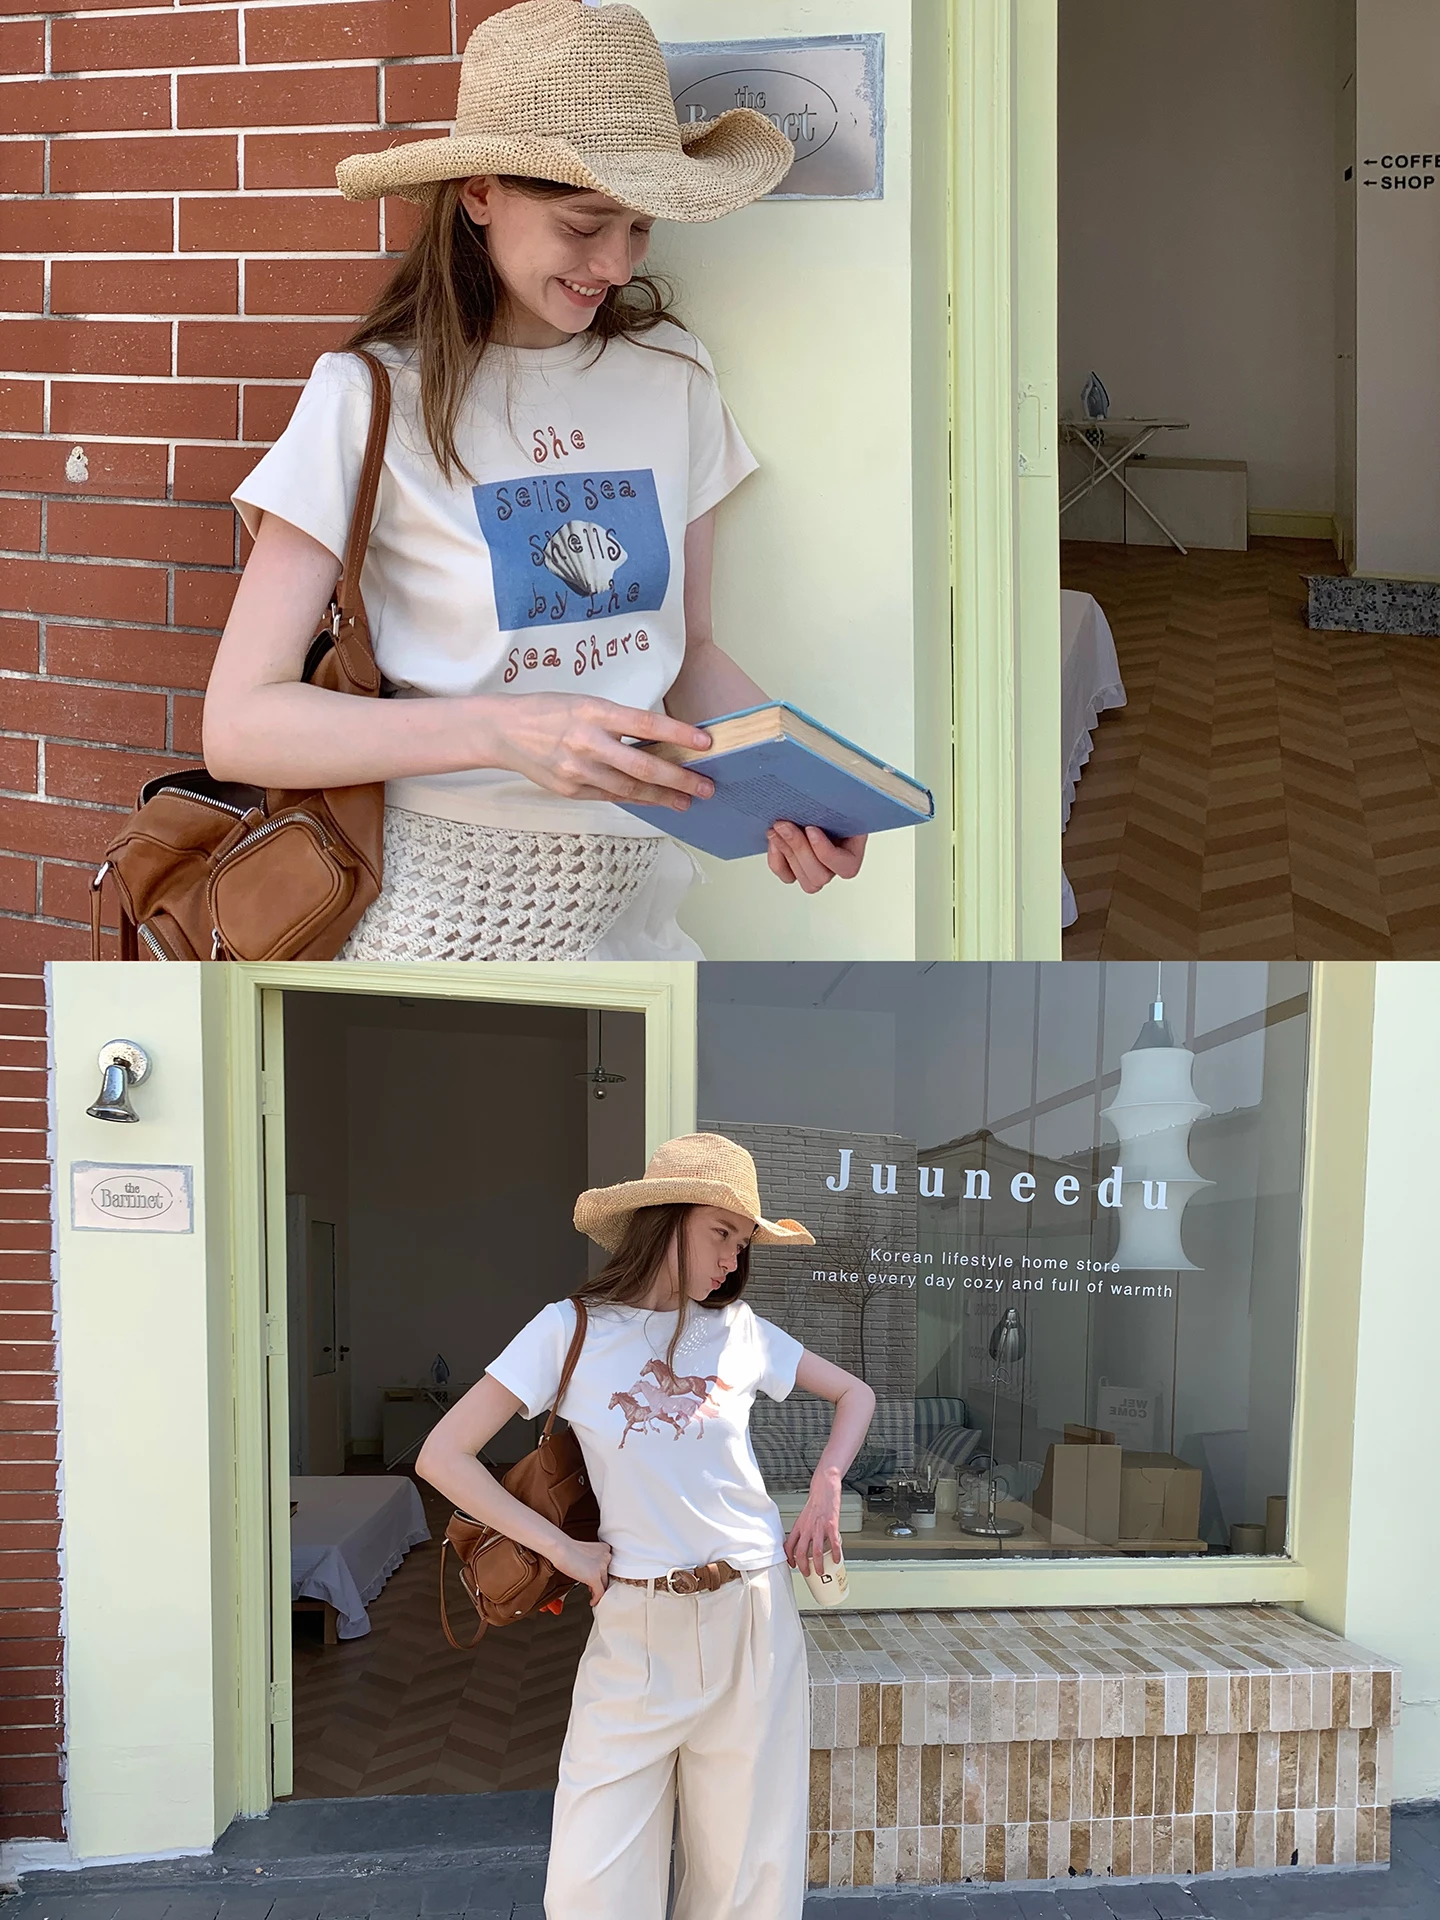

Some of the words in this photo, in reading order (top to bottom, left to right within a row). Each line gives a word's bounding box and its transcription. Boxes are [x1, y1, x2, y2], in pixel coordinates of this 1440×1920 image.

[734, 85, 766, 109] the
[1381, 176, 1435, 189] SHOP
[528, 583, 568, 620] by
[124, 1183, 140, 1193] the
[826, 1148, 1169, 1210] Juuneedu
[870, 1248, 933, 1264] Korean
[942, 1252, 1013, 1270] lifestyle
[1022, 1255, 1068, 1270] home
[1076, 1259, 1121, 1273] store
[812, 1269, 859, 1283] make
[868, 1273, 916, 1289] every
[925, 1273, 955, 1290] day
[963, 1277, 1004, 1293] cozy
[1012, 1278, 1044, 1291] and
[1052, 1279, 1079, 1292] full
[1087, 1281, 1103, 1293] of
[1111, 1284, 1173, 1298] warmth
